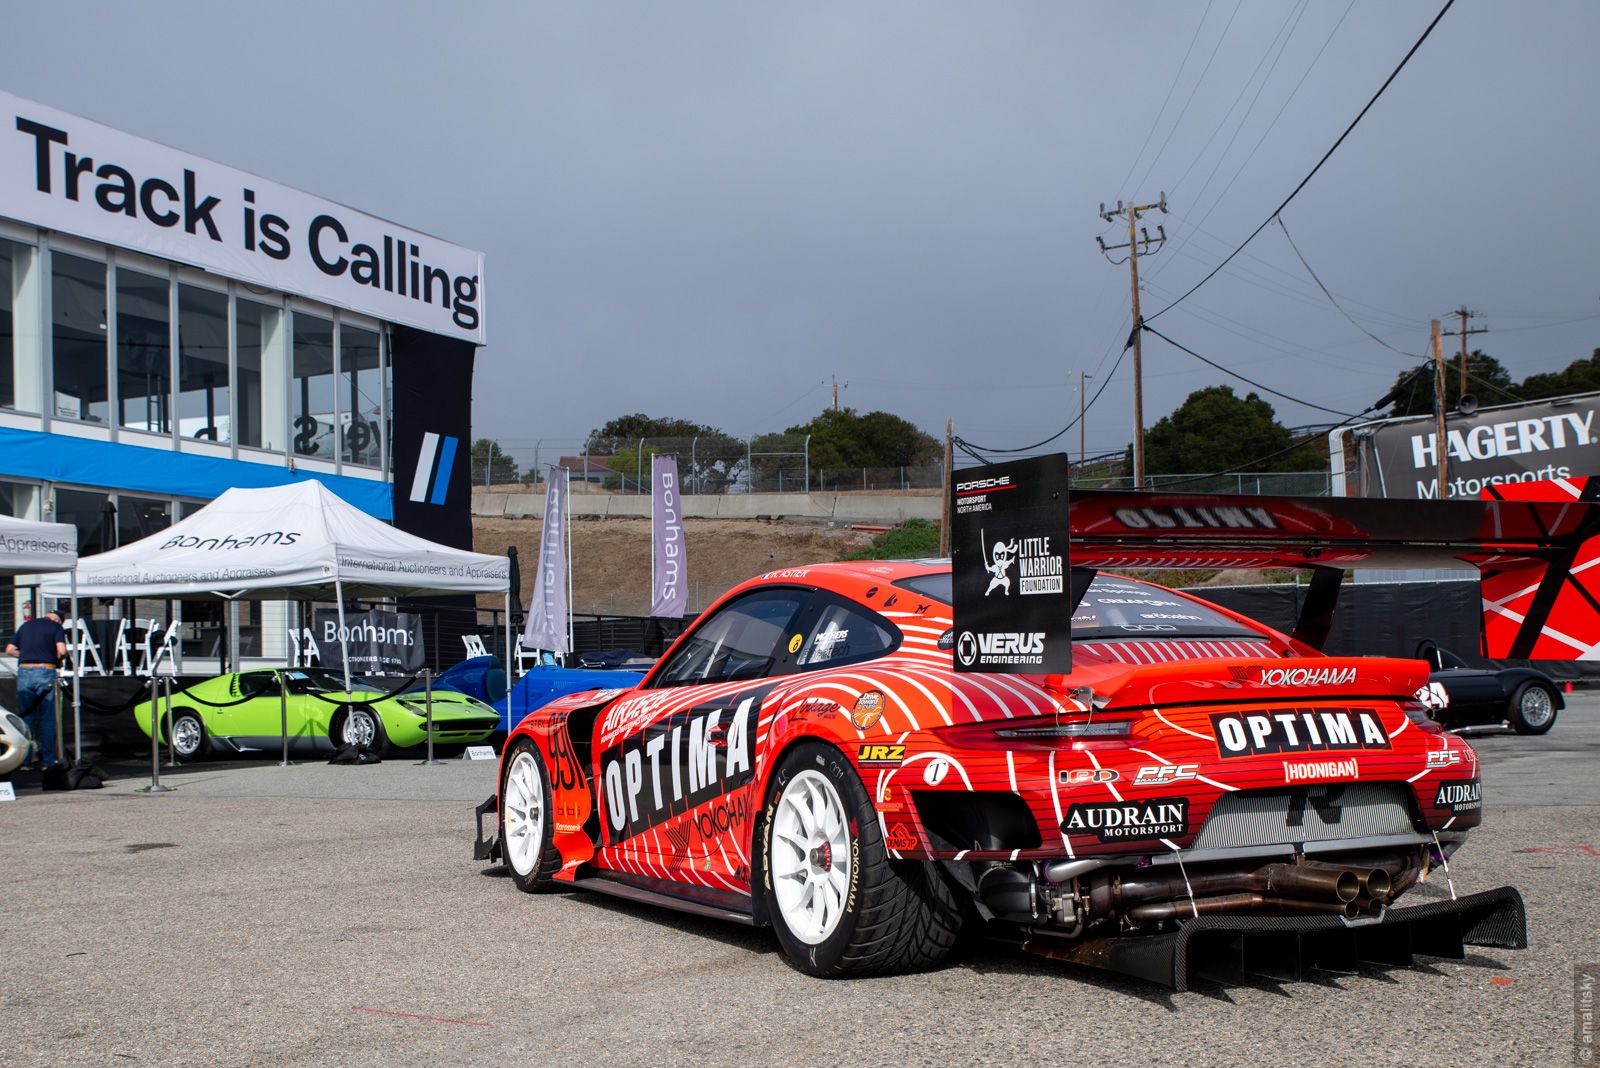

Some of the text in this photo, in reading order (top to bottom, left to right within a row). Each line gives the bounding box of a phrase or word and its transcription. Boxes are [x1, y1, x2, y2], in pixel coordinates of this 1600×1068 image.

[15, 115, 479, 330] Track is Calling
[1411, 410, 1594, 468] HAGERTY
[956, 475, 1010, 492] PORSCHE
[956, 495, 987, 506] MOTORSPORT
[957, 503, 992, 514] NORTH AMERICA
[0, 534, 69, 554] Appraisers
[160, 531, 301, 550] Bonhams
[662, 473, 681, 600] Bonhams
[1018, 536, 1050, 558] LITTLE
[86, 567, 276, 585] International Auctioneers and Appraisers
[341, 557, 507, 580] International Auctioneers and Appraisers
[1019, 555, 1063, 577] WARRIOR
[1021, 578, 1061, 593] FOUNDATION
[324, 619, 414, 647] Bonhams
[977, 632, 1046, 654] VERUS
[980, 655, 1043, 664] ENGINEERING
[1260, 667, 1357, 687] YOKOHAMA
[1218, 712, 1386, 752] OPTIMA
[858, 745, 906, 760] JRZ
[1427, 750, 1460, 763] PFC
[605, 696, 755, 831] OPTIMA
[1135, 764, 1199, 780] PFC
[1067, 803, 1184, 829] AUDRAIN
[1104, 824, 1184, 837] MOTORSPORT
[763, 803, 773, 891] ADVAN
[846, 838, 860, 914] YOKOHAMA
